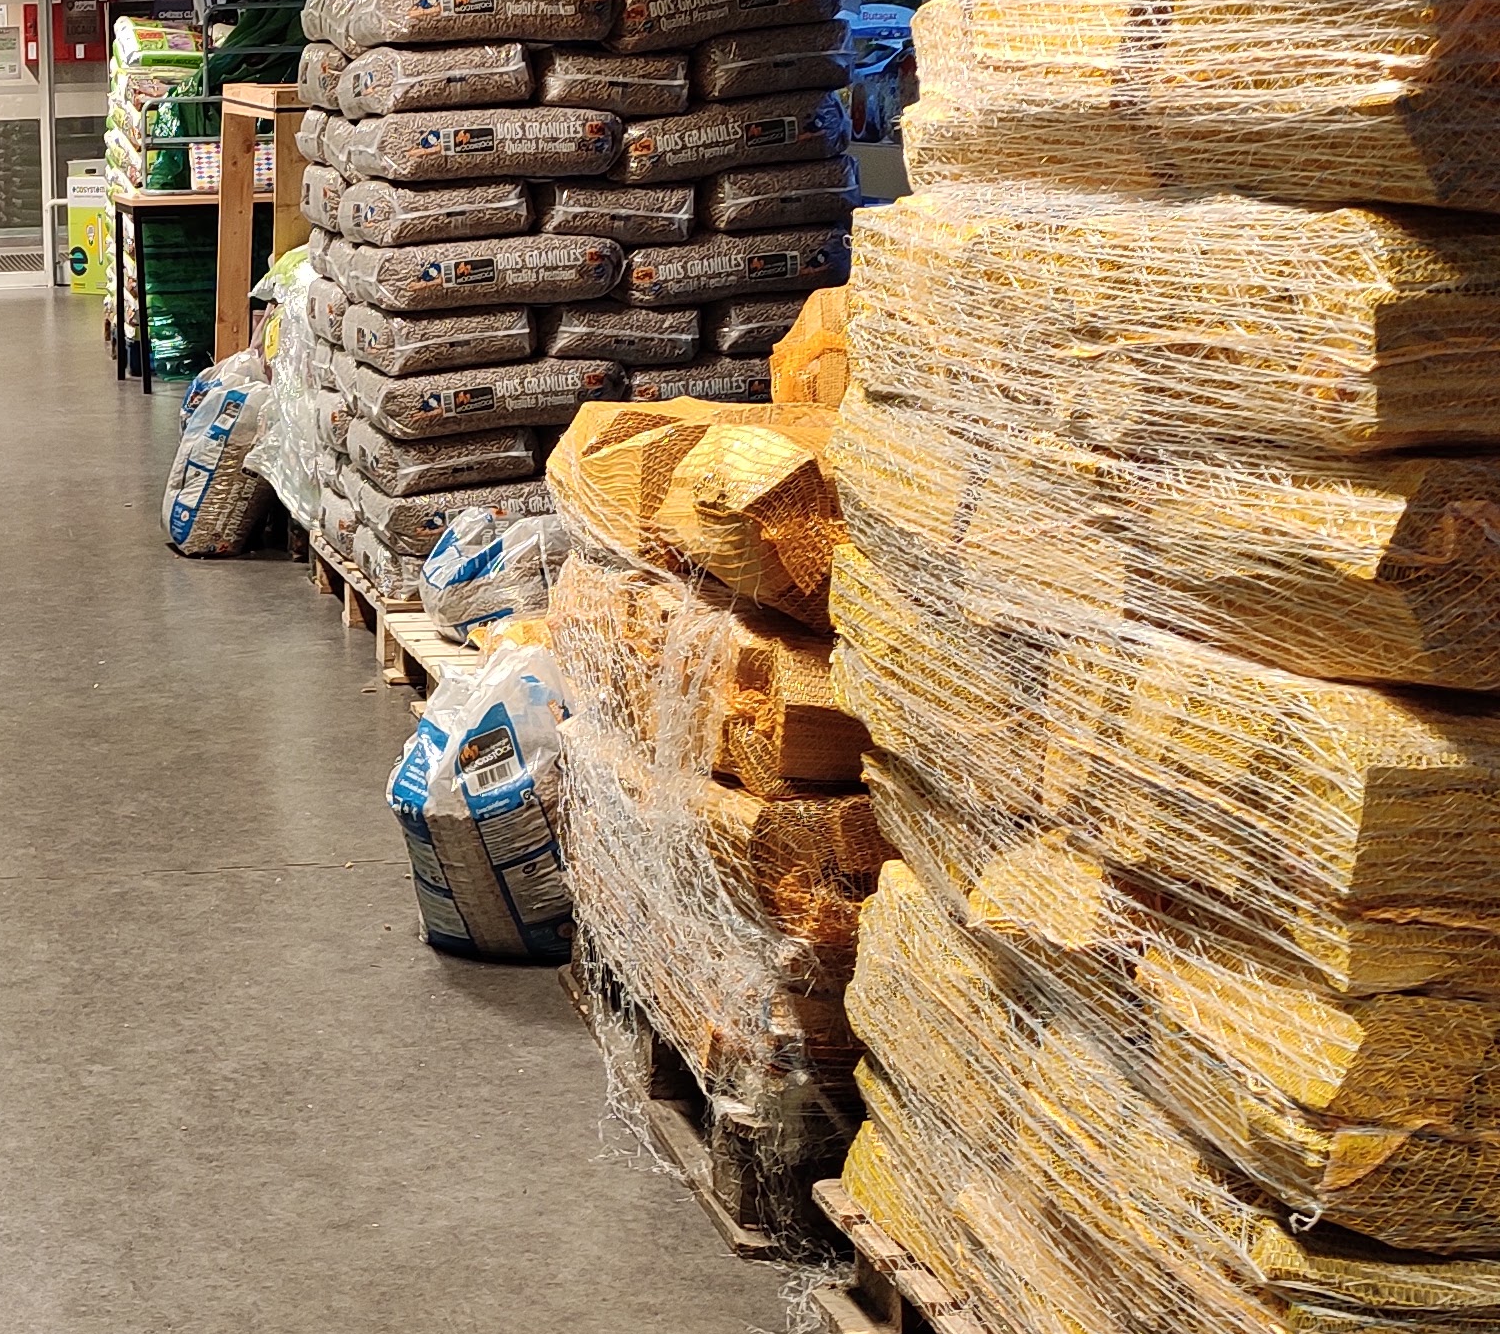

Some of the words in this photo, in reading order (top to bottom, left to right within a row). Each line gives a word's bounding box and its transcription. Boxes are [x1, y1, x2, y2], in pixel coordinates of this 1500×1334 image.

[506, 2, 536, 16] Qualité
[649, 0, 677, 18] BOIS
[862, 11, 897, 22] Butagaz
[660, 13, 691, 31] Qualité
[497, 122, 523, 139] BOIS
[526, 118, 583, 138] GRANULÉS
[657, 133, 683, 151] BOIS
[685, 119, 743, 146] GRANULÉS
[506, 139, 536, 154] Qualité
[666, 147, 697, 166] Qualité
[497, 252, 523, 269] BOIS
[526, 248, 584, 267] GRANULÉS
[658, 263, 685, 281] BOIS
[687, 254, 746, 276] GRANULÉS
[506, 269, 536, 284] Qualité
[495, 380, 521, 397] BOIS
[524, 371, 582, 394] GRANULÉS
[660, 381, 686, 399] BOIS
[505, 396, 536, 412] Qualité
